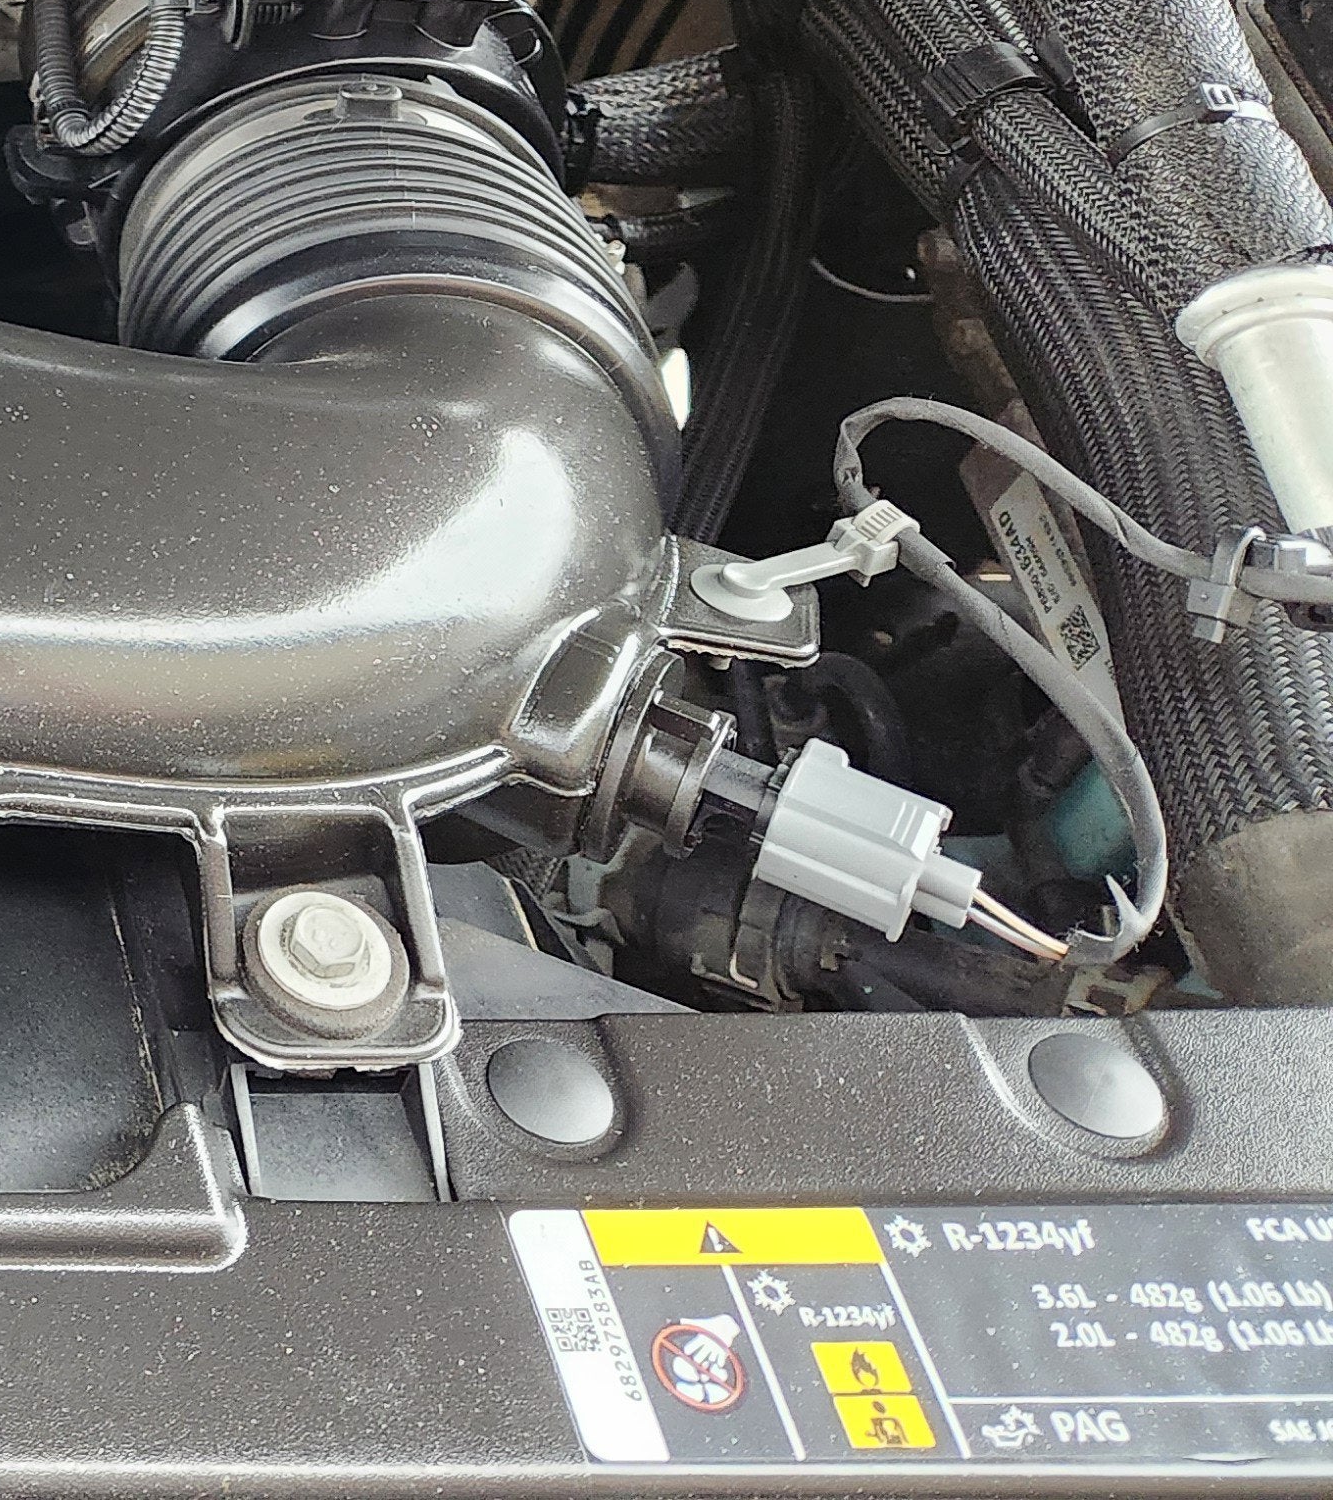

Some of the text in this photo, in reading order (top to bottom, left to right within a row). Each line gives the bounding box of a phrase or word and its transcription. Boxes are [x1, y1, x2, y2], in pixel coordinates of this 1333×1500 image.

[942, 1218, 1097, 1256] R-1234yf
[1246, 1216, 1333, 1243] FCA U
[1031, 1283, 1097, 1311] 3.6L
[1129, 1282, 1204, 1313] 482g
[1207, 1280, 1285, 1313] (1.06
[584, 1257, 645, 1405] 68297583AB
[799, 1302, 898, 1330] R-1234yf
[1050, 1321, 1117, 1349] 2.0L
[1149, 1320, 1224, 1353] 482g
[1227, 1319, 1305, 1352] (1.06
[1049, 1410, 1131, 1443] PAG
[1269, 1419, 1317, 1443] SAE
